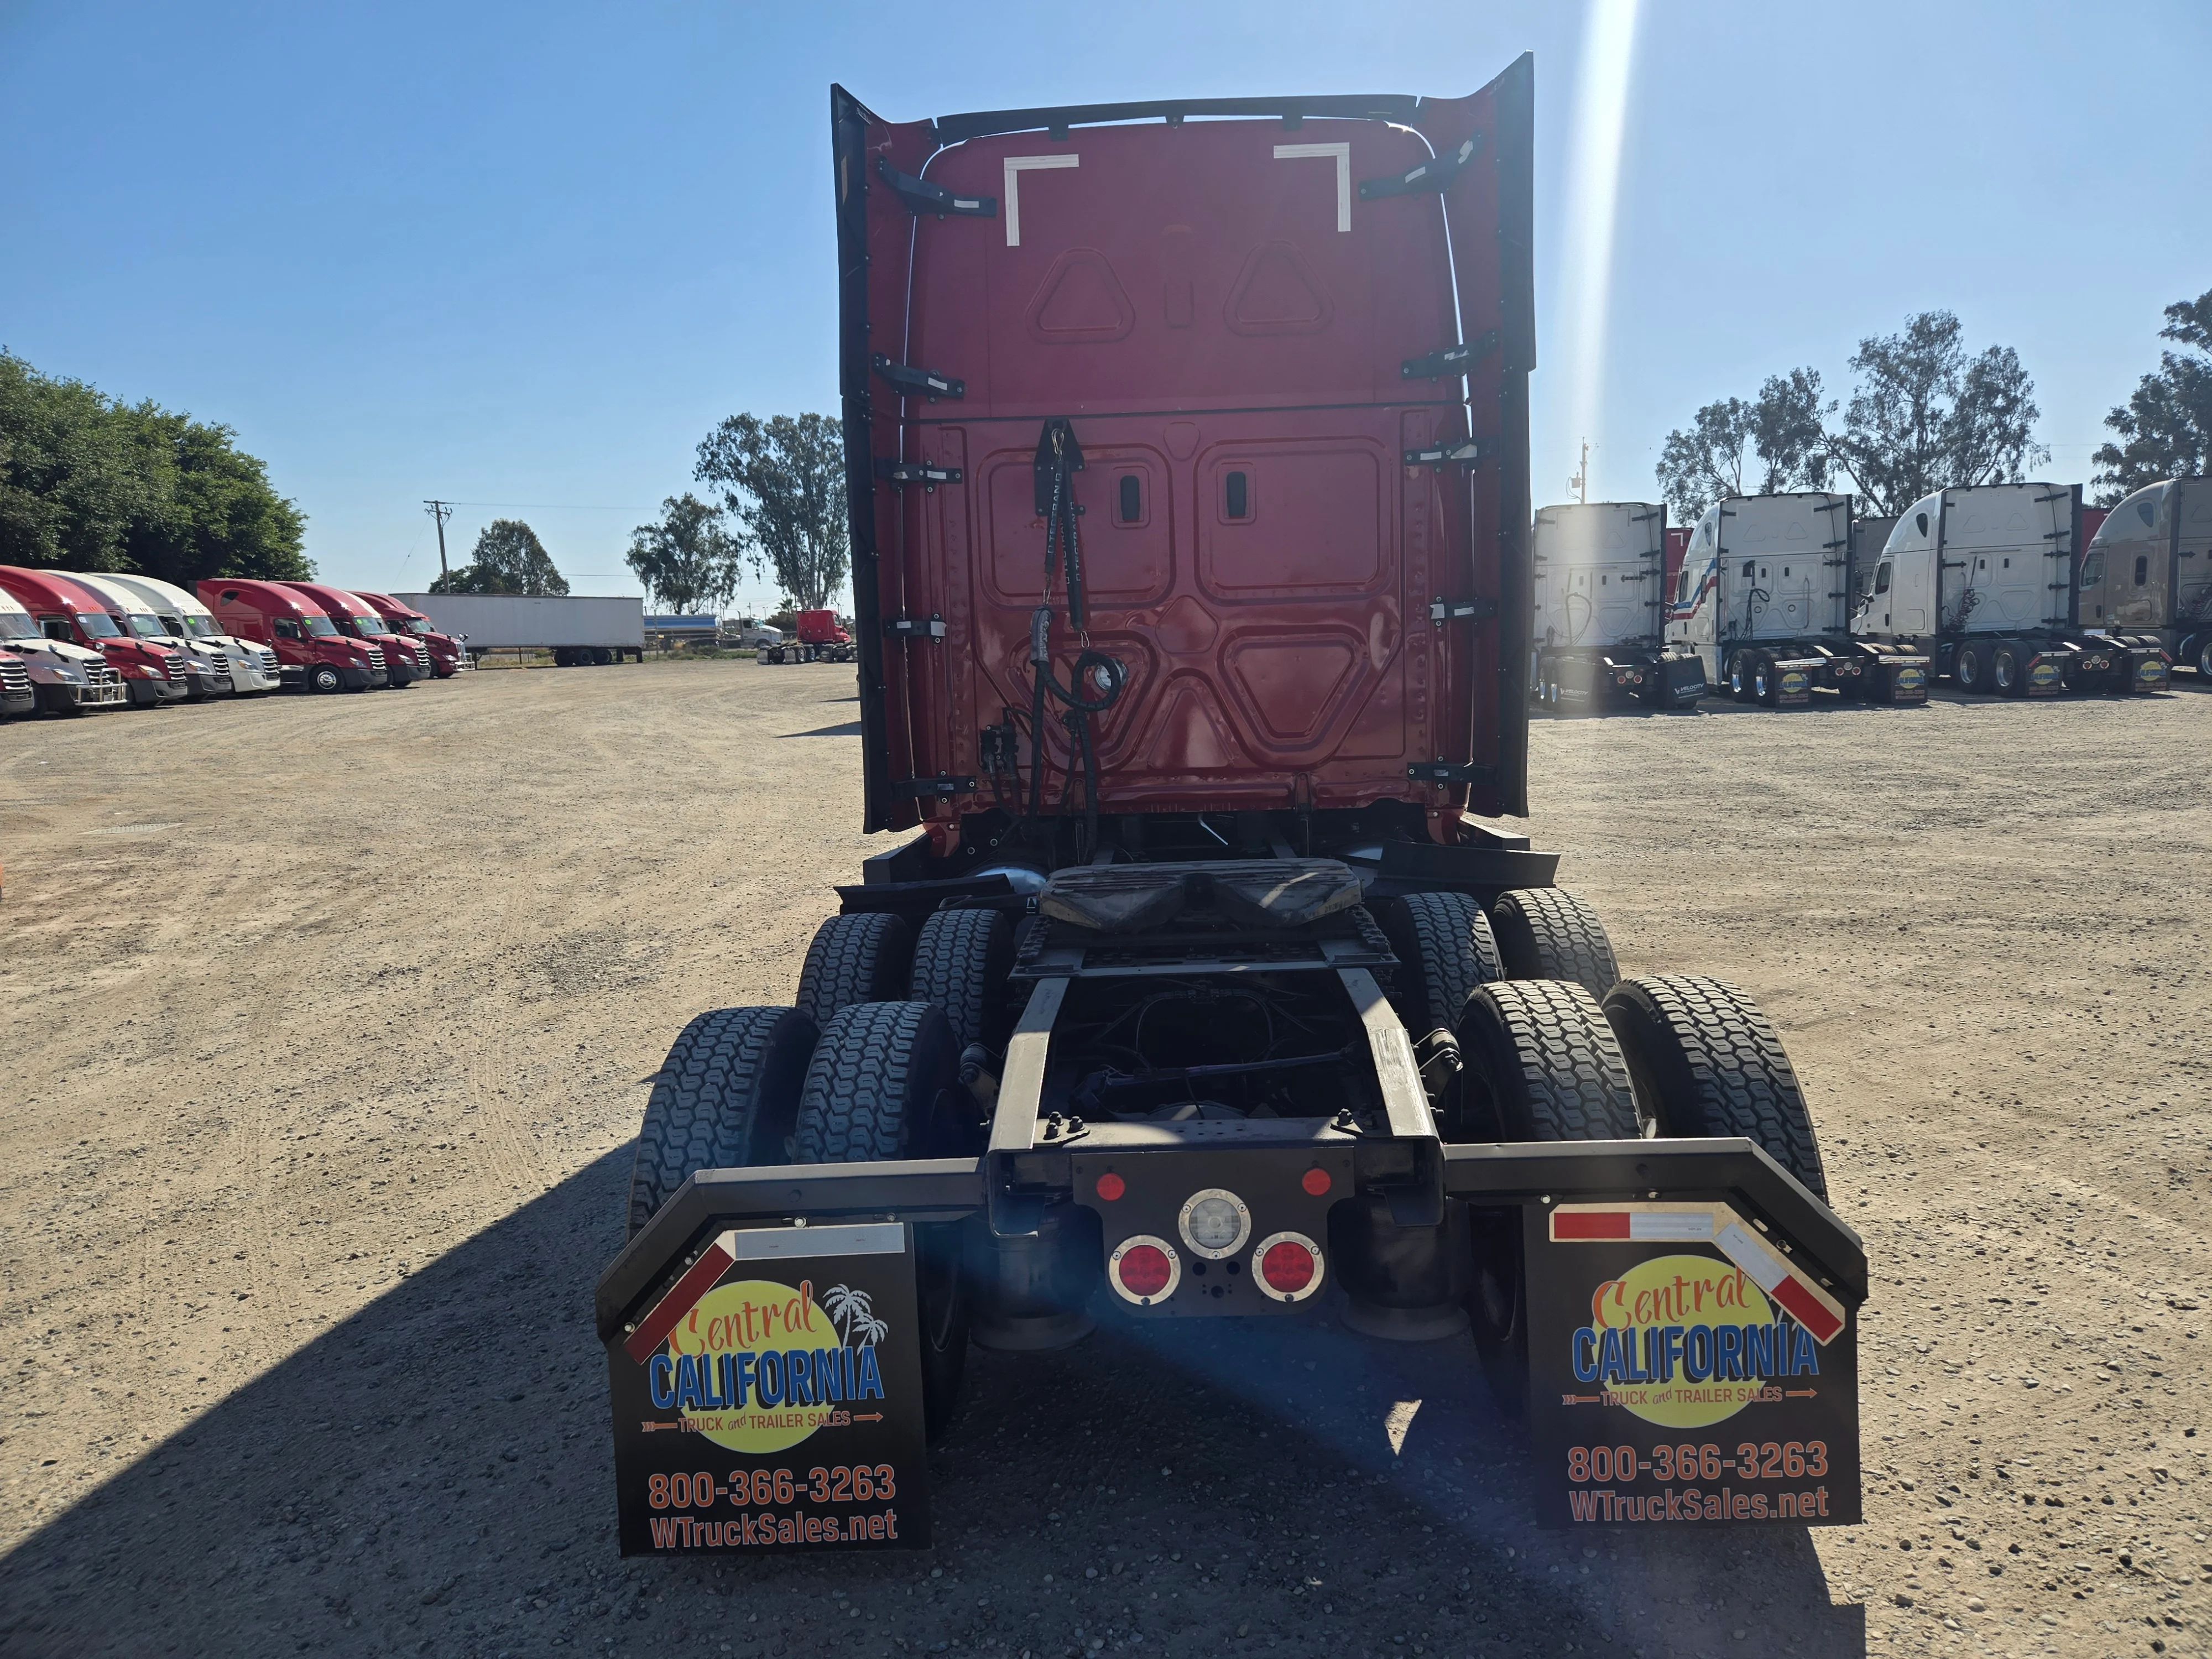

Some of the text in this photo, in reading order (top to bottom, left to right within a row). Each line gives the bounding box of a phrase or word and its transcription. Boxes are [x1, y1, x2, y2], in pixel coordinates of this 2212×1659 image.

[1048, 484, 1060, 542] TECTRAN
[1681, 682, 1704, 691] VELOCITY
[668, 1280, 817, 1359] Central
[1592, 1264, 1751, 1332] Central
[1572, 1323, 1819, 1382] CALIFORNIA
[650, 1345, 885, 1410] CALIFORNIA
[1600, 1386, 1783, 1406] TRUCK and TRAILER SALES
[678, 1411, 851, 1433] TRUCK and TRAILER SALES
[1568, 1441, 1828, 1482] 800-366-3263
[648, 1464, 896, 1509] 800-366-3263
[1569, 1485, 1829, 1521] WTruckSales.net
[650, 1509, 898, 1548] WTruckSales.net
